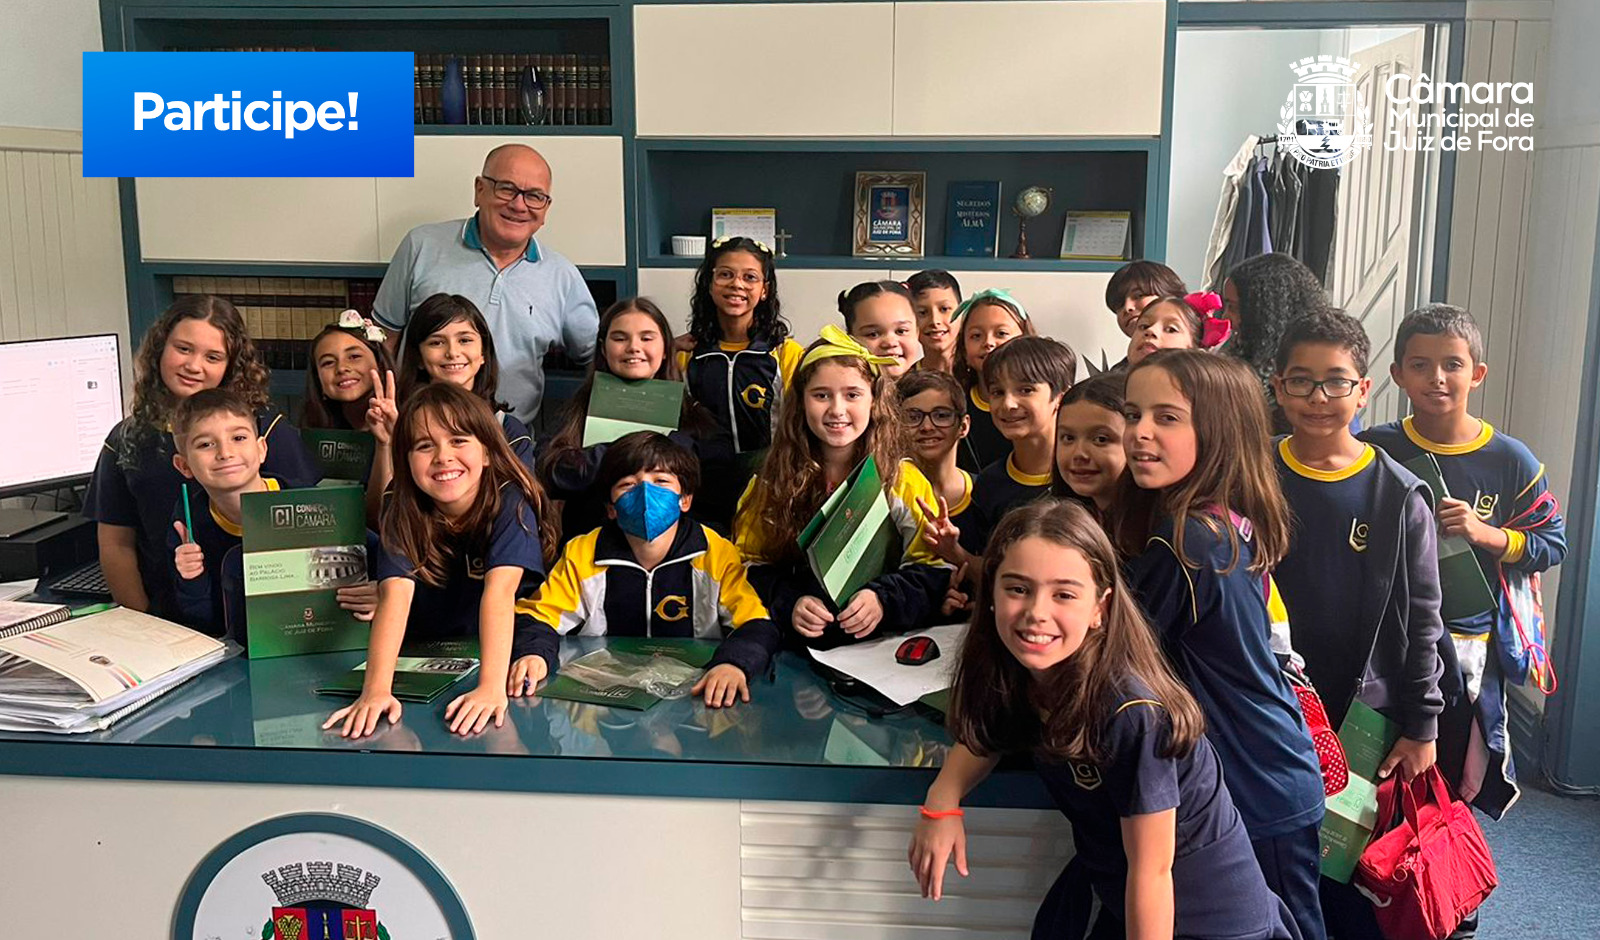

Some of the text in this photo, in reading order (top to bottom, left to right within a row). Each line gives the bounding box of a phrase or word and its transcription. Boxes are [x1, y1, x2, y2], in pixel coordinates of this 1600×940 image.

[873, 219, 902, 227] CÂMARA
[962, 218, 985, 228] ALMA
[741, 383, 767, 409] G
[653, 594, 690, 621] G
